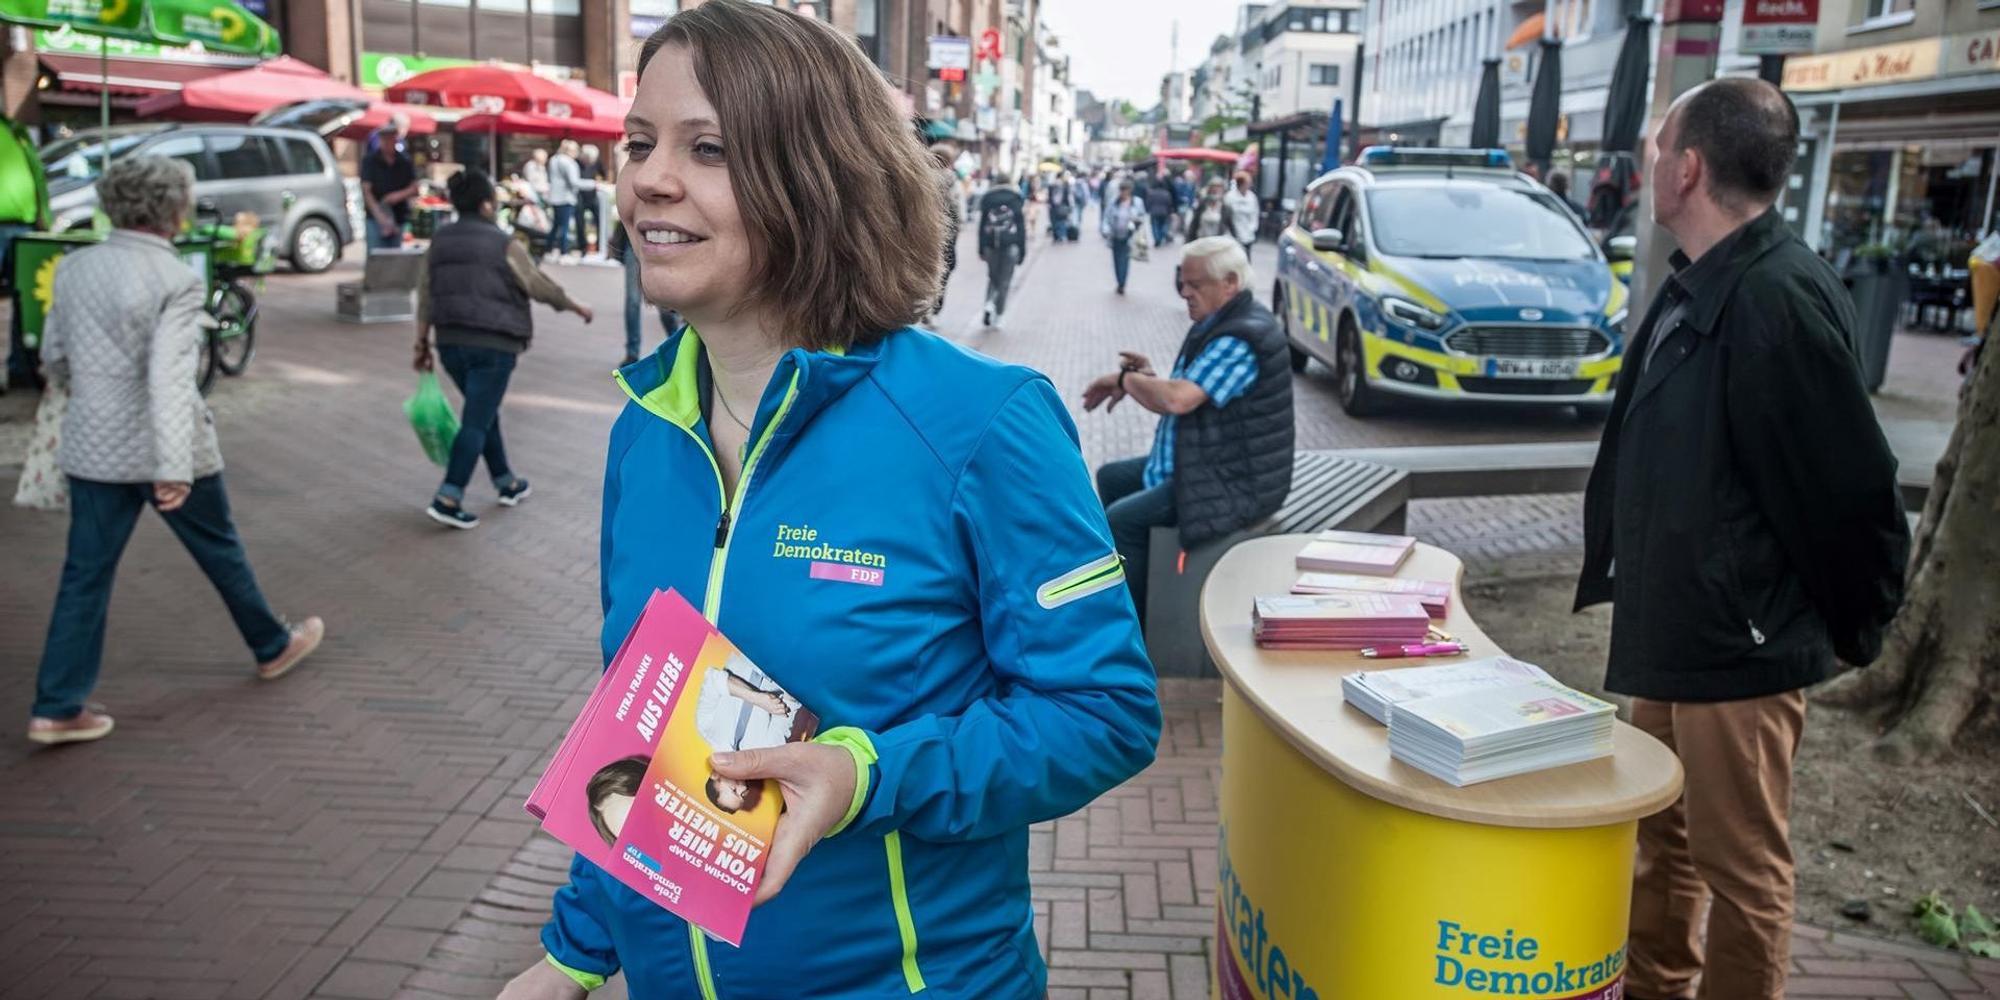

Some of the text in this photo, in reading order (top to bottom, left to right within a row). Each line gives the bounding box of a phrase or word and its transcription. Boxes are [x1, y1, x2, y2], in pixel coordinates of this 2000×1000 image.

[1967, 37, 2000, 66] CA
[776, 524, 818, 541] Freie
[773, 542, 886, 568] Demokraten
[850, 569, 880, 583] FDP
[615, 653, 653, 722] PETRA FRANKE
[636, 652, 684, 743] AUS LIEBE
[654, 783, 720, 841] WEITER.
[668, 820, 757, 885] VON HIER
[722, 833, 762, 862] AUS
[622, 852, 683, 895] Demokraten
[668, 844, 751, 895] JOACHIM STAMP
[653, 883, 680, 904] Freie
[1436, 920, 1539, 961] Freie
